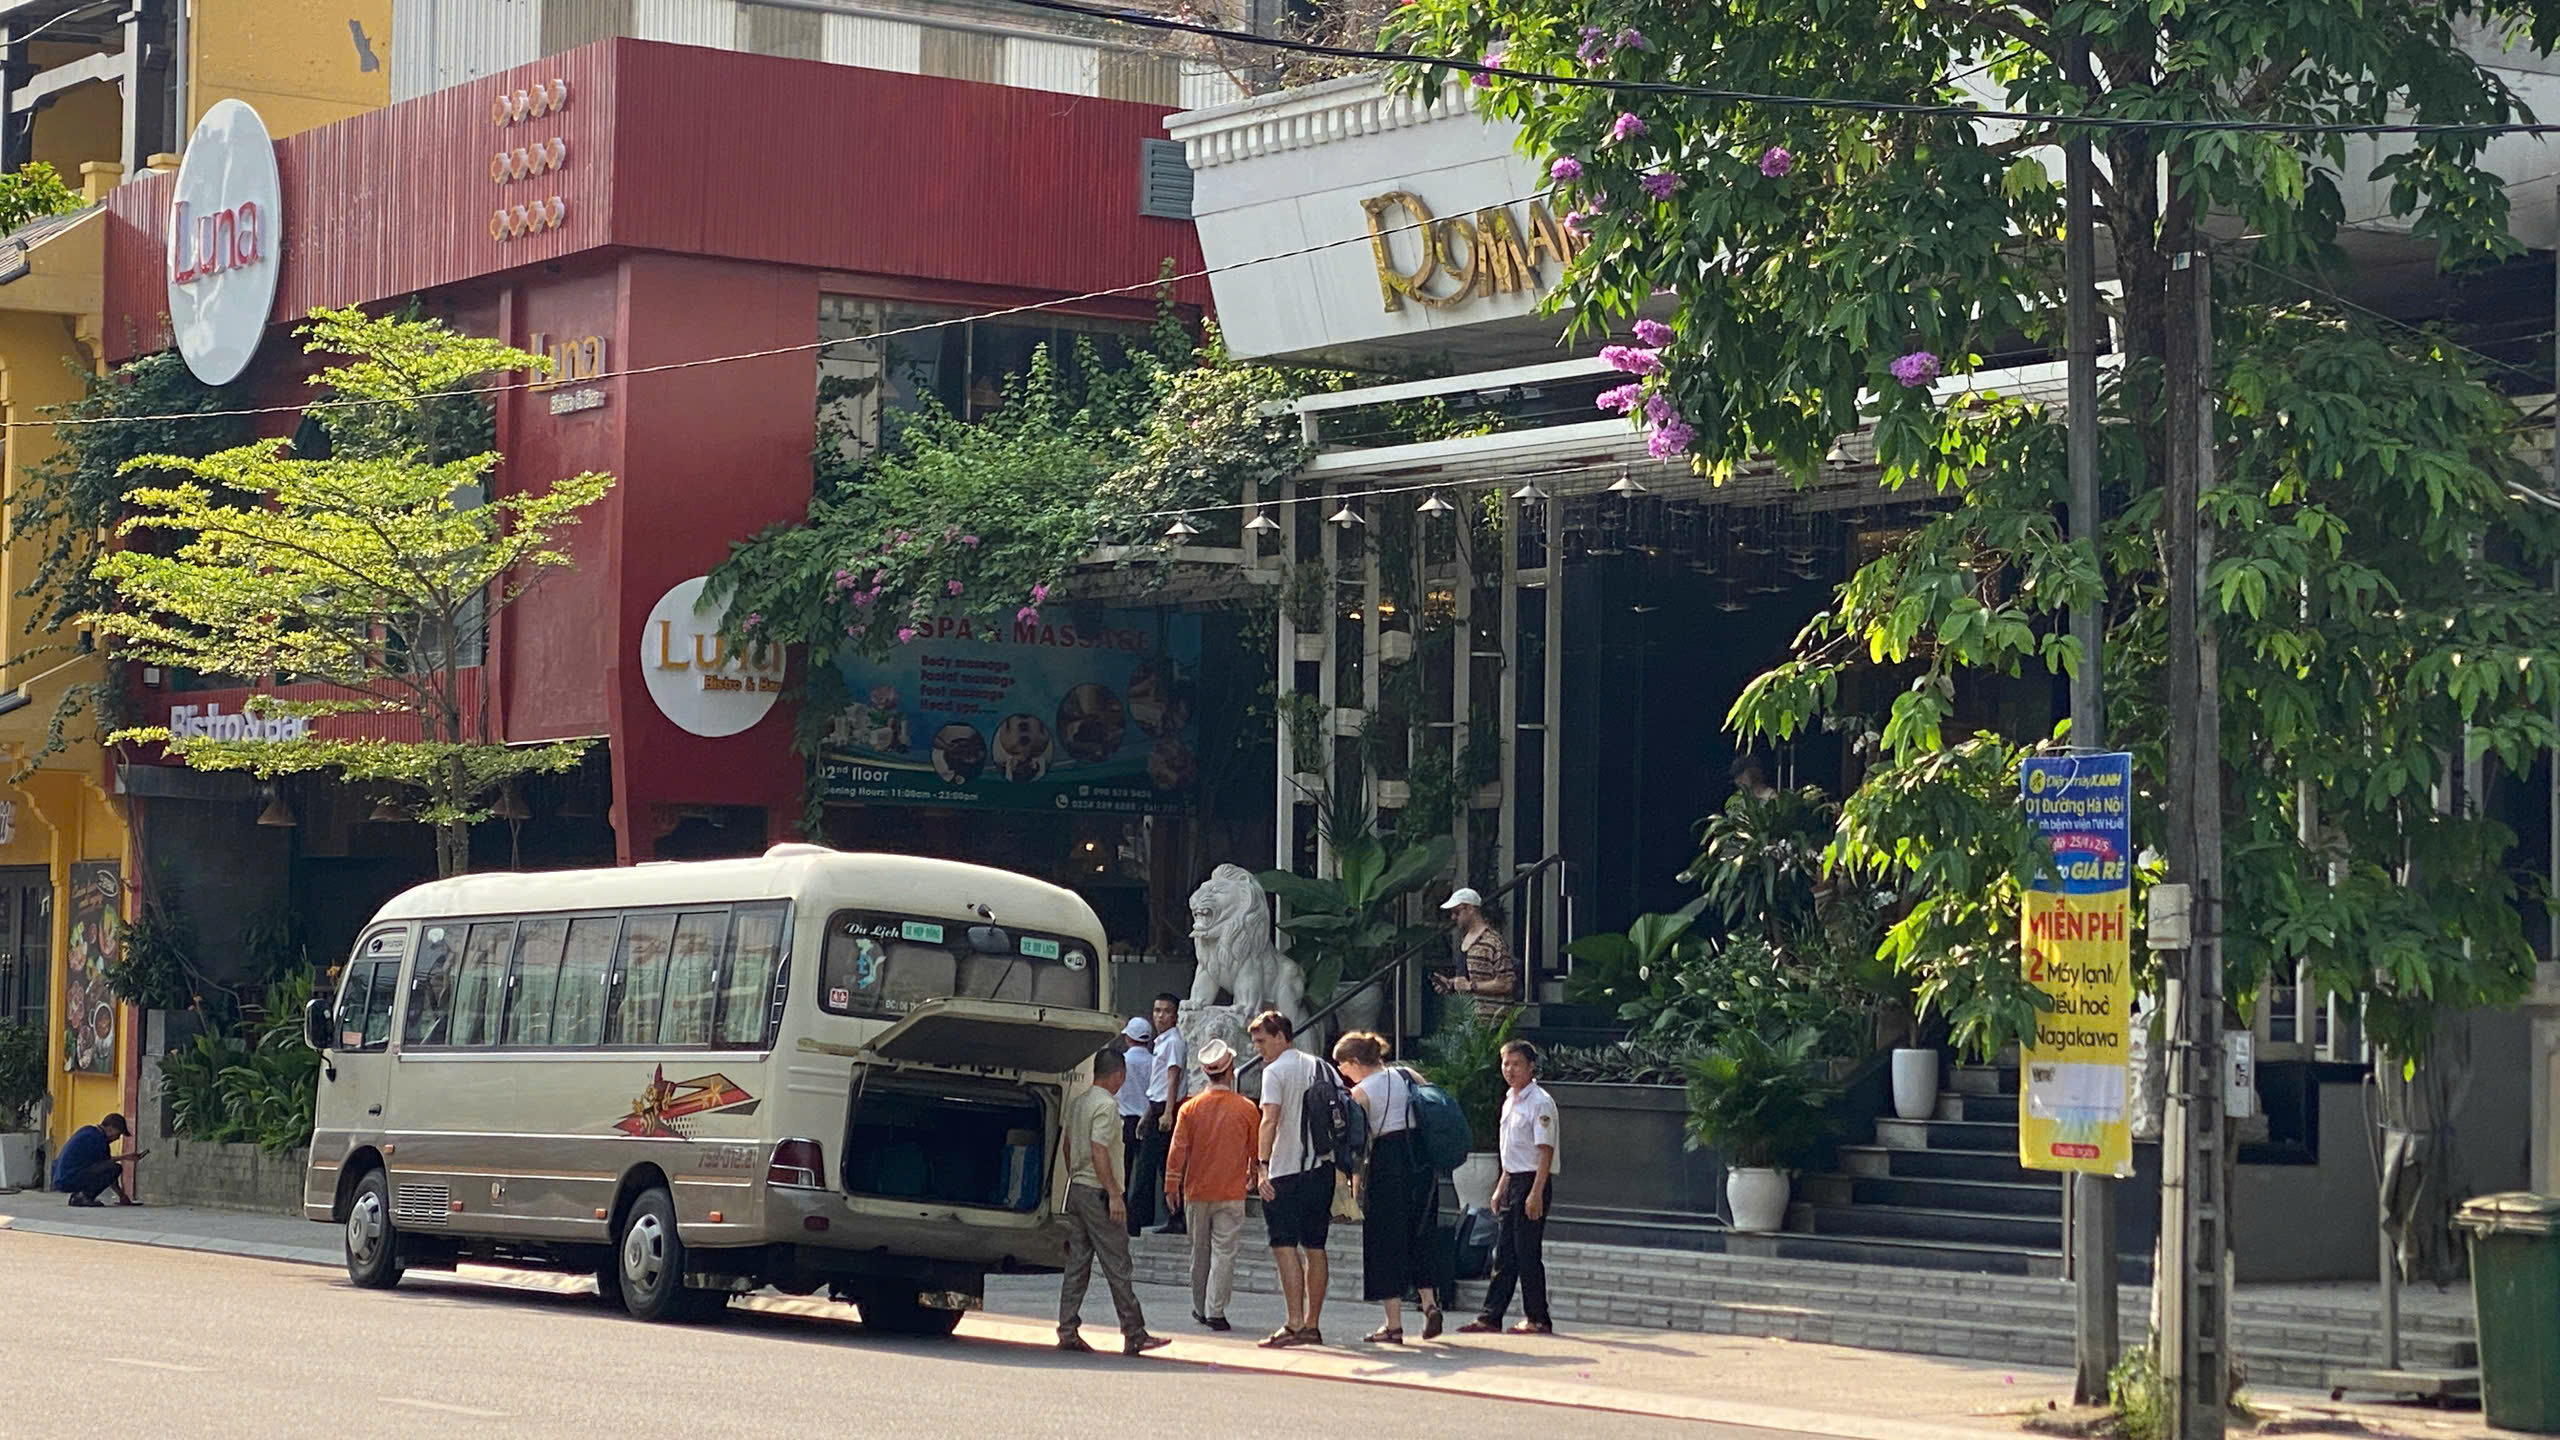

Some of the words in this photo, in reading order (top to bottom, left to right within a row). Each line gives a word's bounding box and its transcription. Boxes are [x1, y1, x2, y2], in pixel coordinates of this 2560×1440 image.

[174, 200, 264, 284] Luna
[918, 616, 973, 640] SPA
[921, 655, 950, 671] Body
[955, 658, 1010, 673] massage
[704, 674, 742, 690] Bistro
[745, 676, 755, 691] &
[920, 669, 957, 682] Facial
[960, 673, 1016, 688] massage
[920, 684, 946, 697] Foot
[950, 687, 1005, 703] massage
[920, 698, 953, 712] Head
[851, 767, 890, 783] floor
[2042, 796, 2086, 817] Đường
[2087, 796, 2102, 813] Hà
[2104, 796, 2125, 816] Nội
[2070, 857, 2101, 880] GIÁ
[2102, 855, 2126, 880] RẺ
[843, 922, 867, 936] Du
[2029, 898, 2083, 941] MIỄN
[2088, 904, 2125, 942] PHÍ
[2029, 947, 2044, 982] 2
[2047, 962, 2080, 988] Máy
[2079, 994, 2110, 1016] hoà
[2036, 1025, 2119, 1051] Nagakawa
